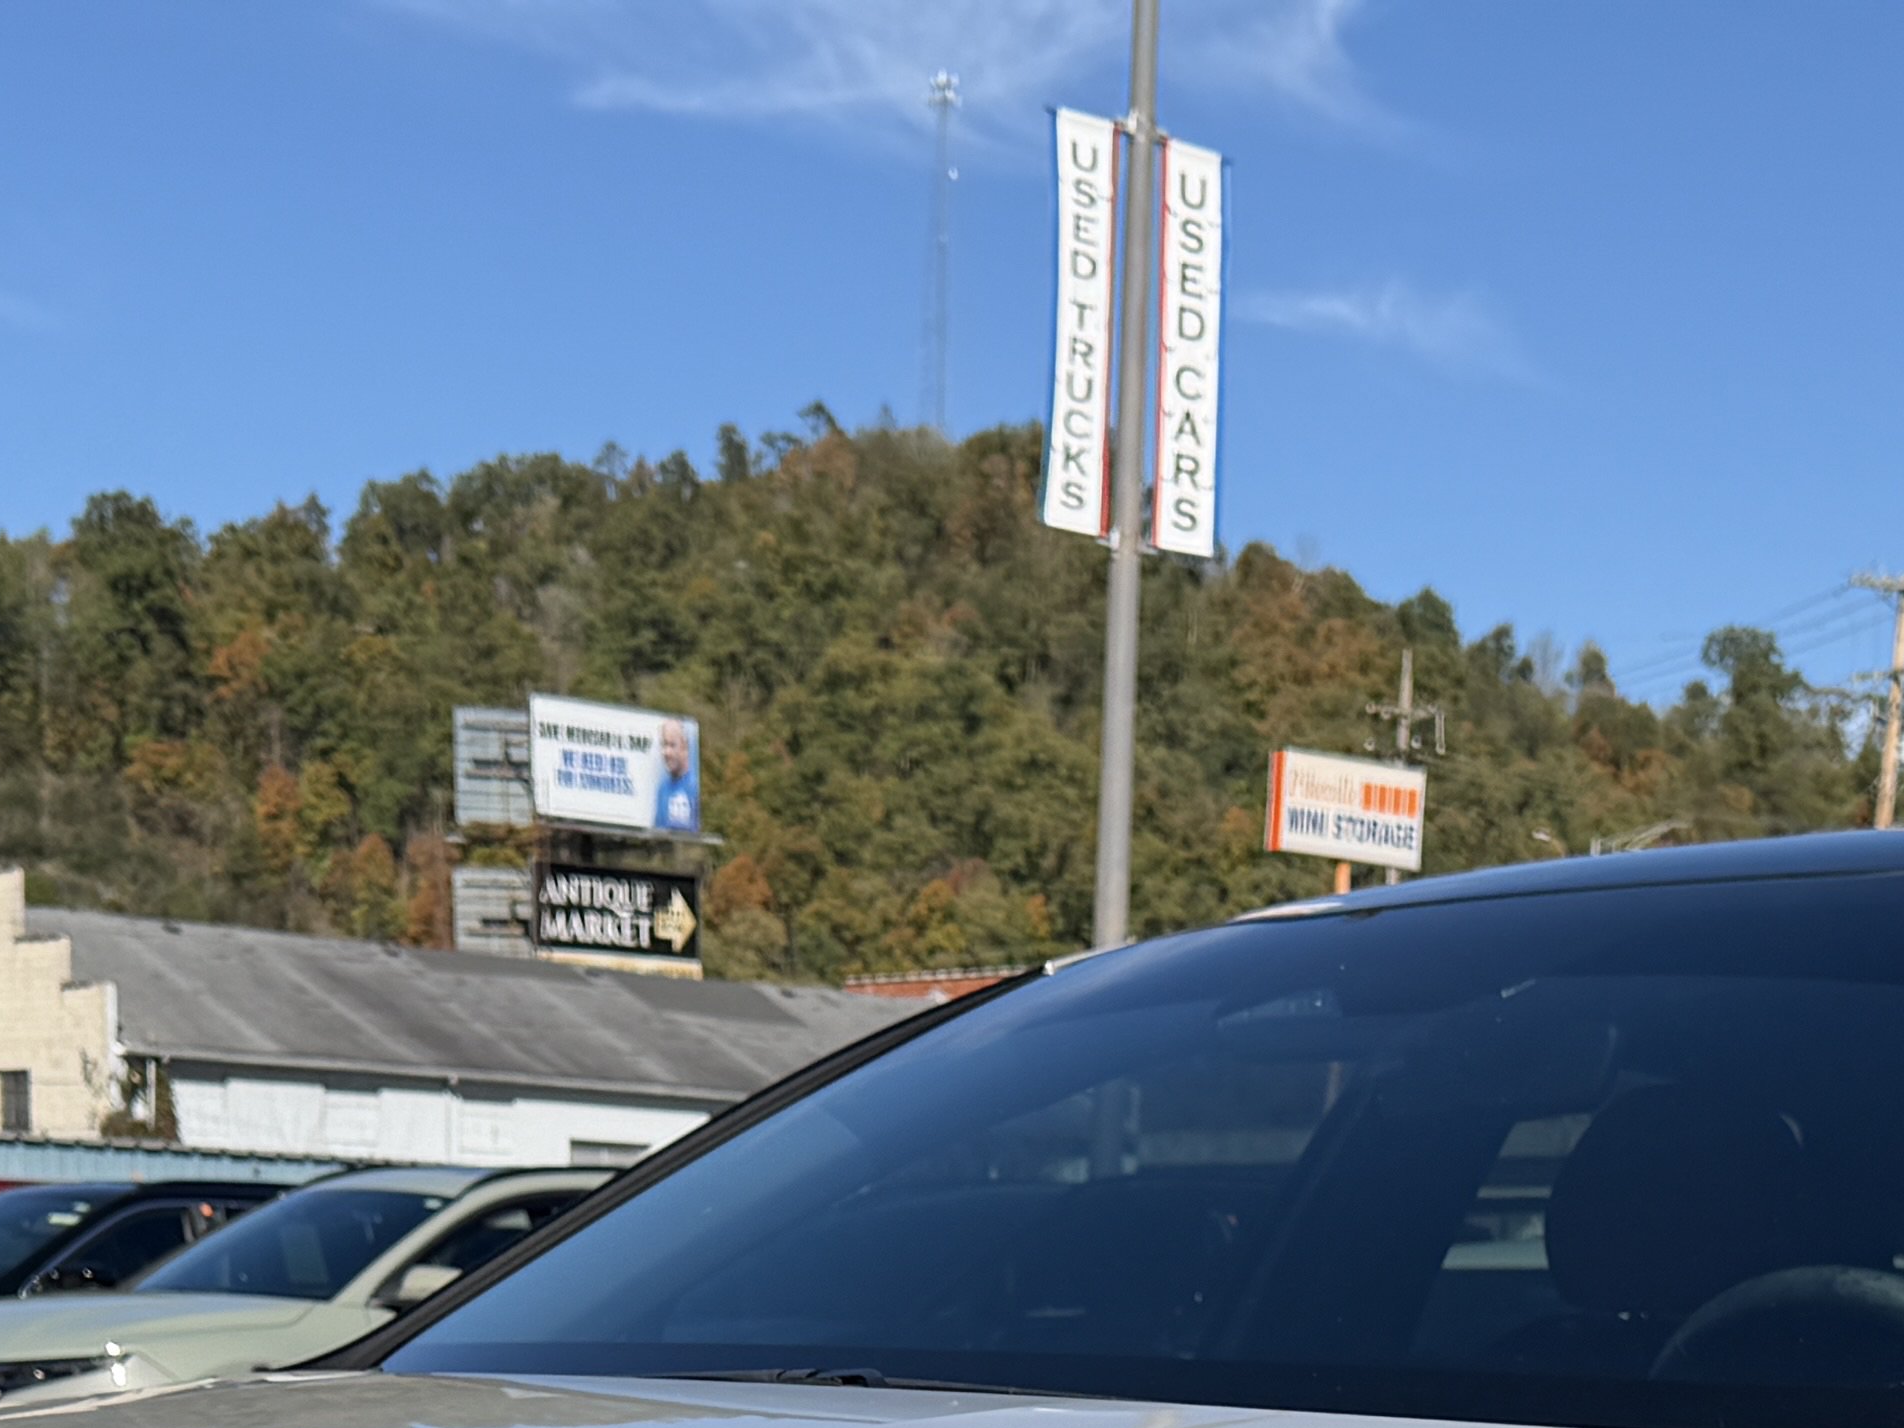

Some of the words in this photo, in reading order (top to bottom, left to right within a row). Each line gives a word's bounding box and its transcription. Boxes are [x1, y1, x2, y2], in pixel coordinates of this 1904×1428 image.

[1071, 139, 1098, 281] USED
[1177, 172, 1206, 341] USED
[1062, 301, 1097, 510] TRUCKS
[1172, 366, 1206, 532] CARS
[539, 871, 654, 915] ANTIQUE
[1334, 814, 1415, 850] STORAGE
[540, 908, 652, 949] MARKET
